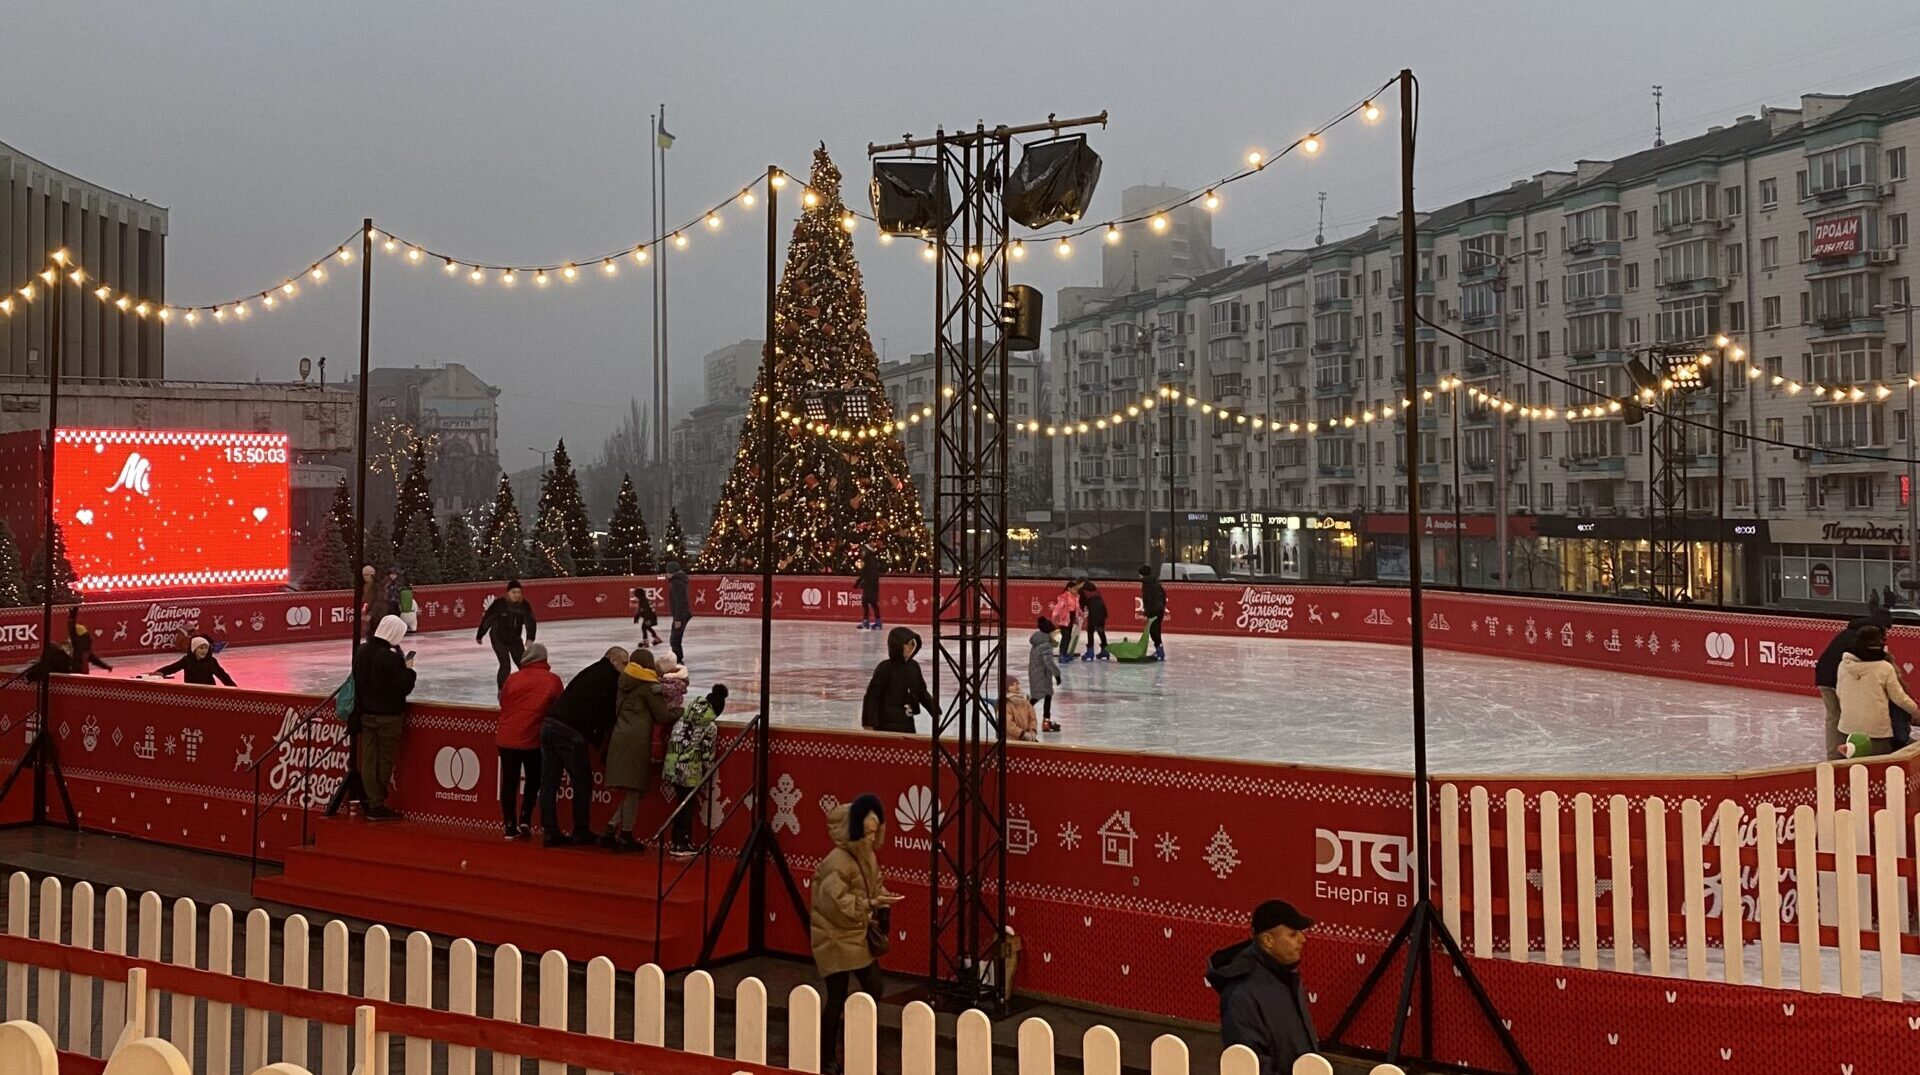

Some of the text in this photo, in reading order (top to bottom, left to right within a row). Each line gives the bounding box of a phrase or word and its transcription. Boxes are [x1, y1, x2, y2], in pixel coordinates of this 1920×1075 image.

[1815, 219, 1858, 239] ПРОДАМ
[224, 447, 286, 463] 15:50:03
[1822, 521, 1903, 544] Персидські
[1237, 587, 1295, 606] Містечко
[142, 603, 200, 622] Містечко
[1236, 604, 1294, 628] Зимових
[1777, 643, 1814, 656] беремо
[435, 790, 478, 803] mastercard
[1315, 880, 1408, 907] Енергія в
